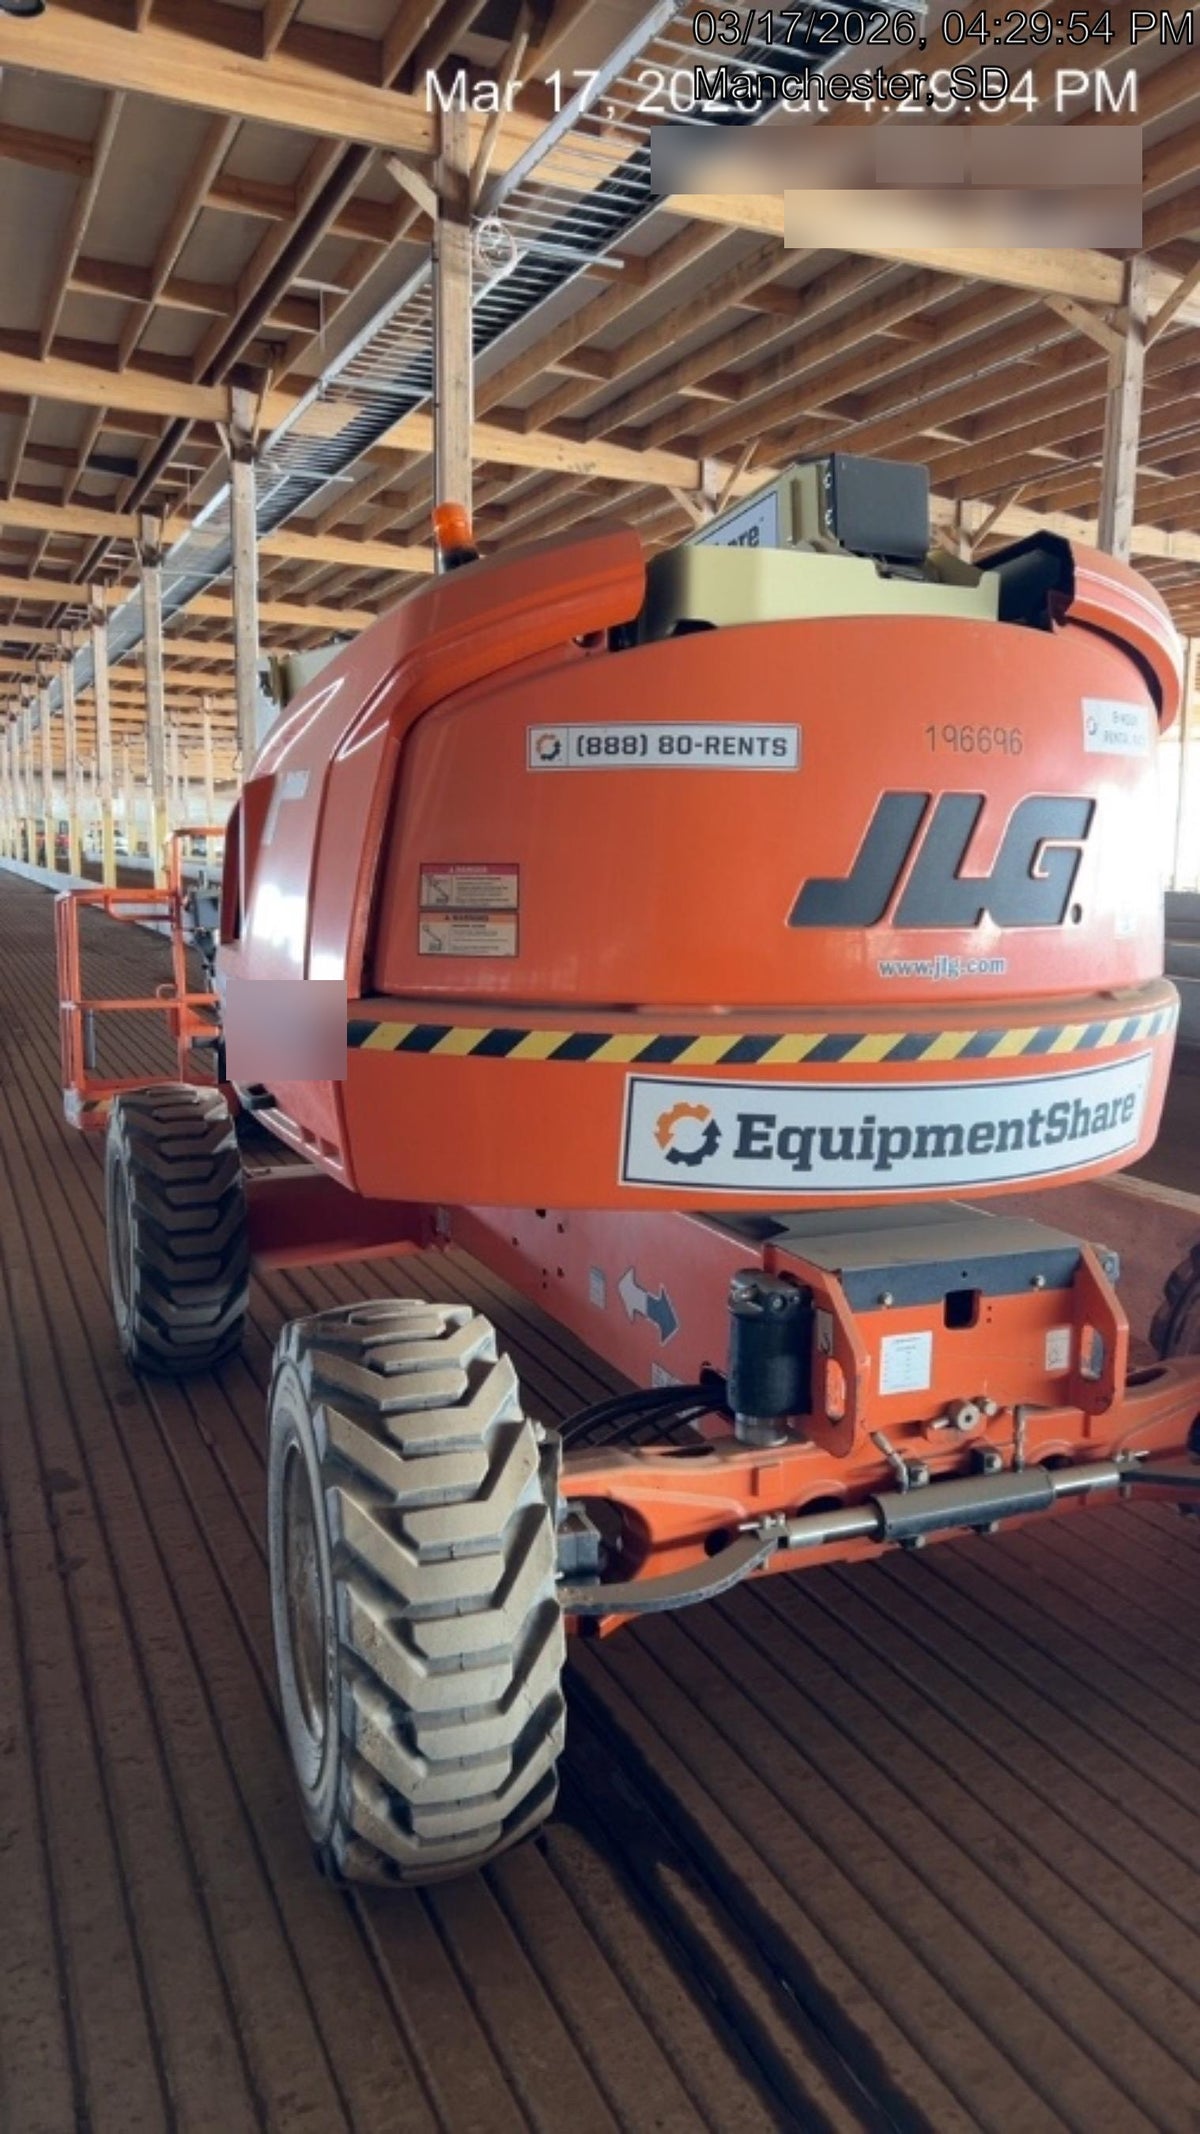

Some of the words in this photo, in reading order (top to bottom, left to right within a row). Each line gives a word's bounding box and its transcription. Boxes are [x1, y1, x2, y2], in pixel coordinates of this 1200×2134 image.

[576, 733, 649, 758] (888)
[658, 734, 788, 758] 80-RENTS
[925, 724, 1023, 756] 196696
[878, 954, 1005, 980] www.jlg.com
[732, 1091, 1136, 1172] EquipmentShare
